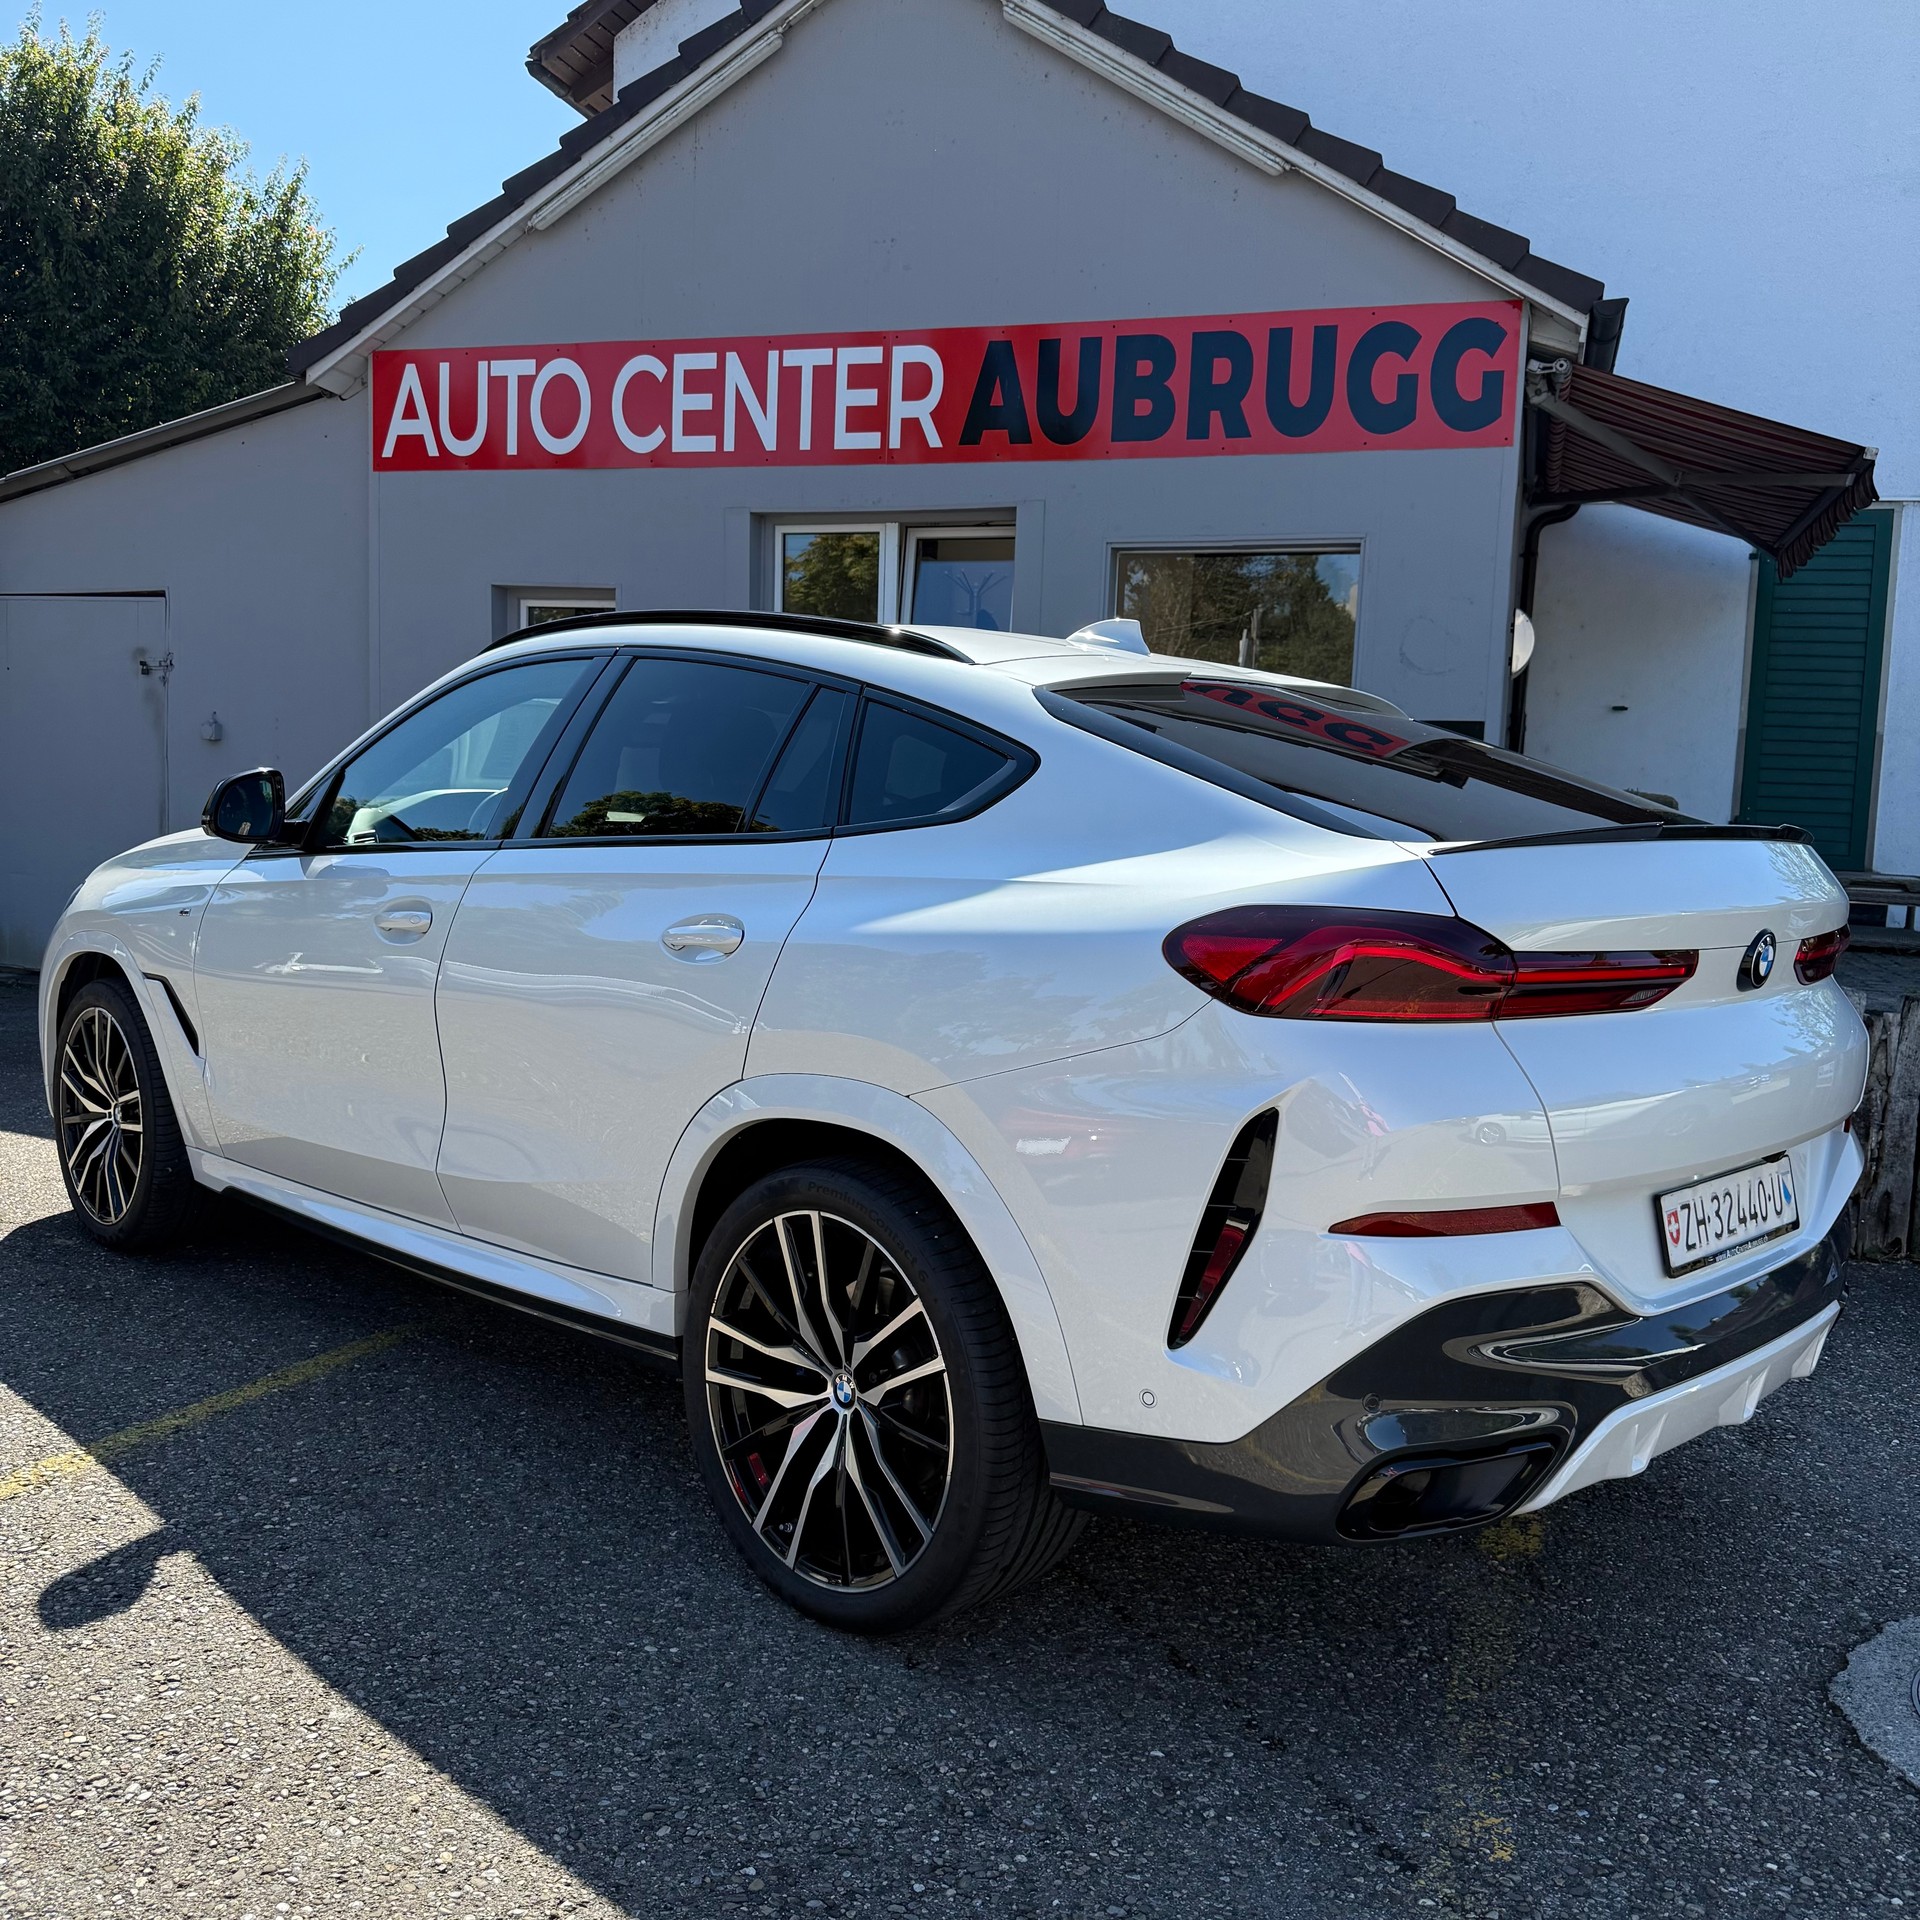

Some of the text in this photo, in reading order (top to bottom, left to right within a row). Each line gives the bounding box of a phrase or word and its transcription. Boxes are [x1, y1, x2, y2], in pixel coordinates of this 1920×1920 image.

[381, 317, 1507, 458] AUTO CENTER AUBRUGG
